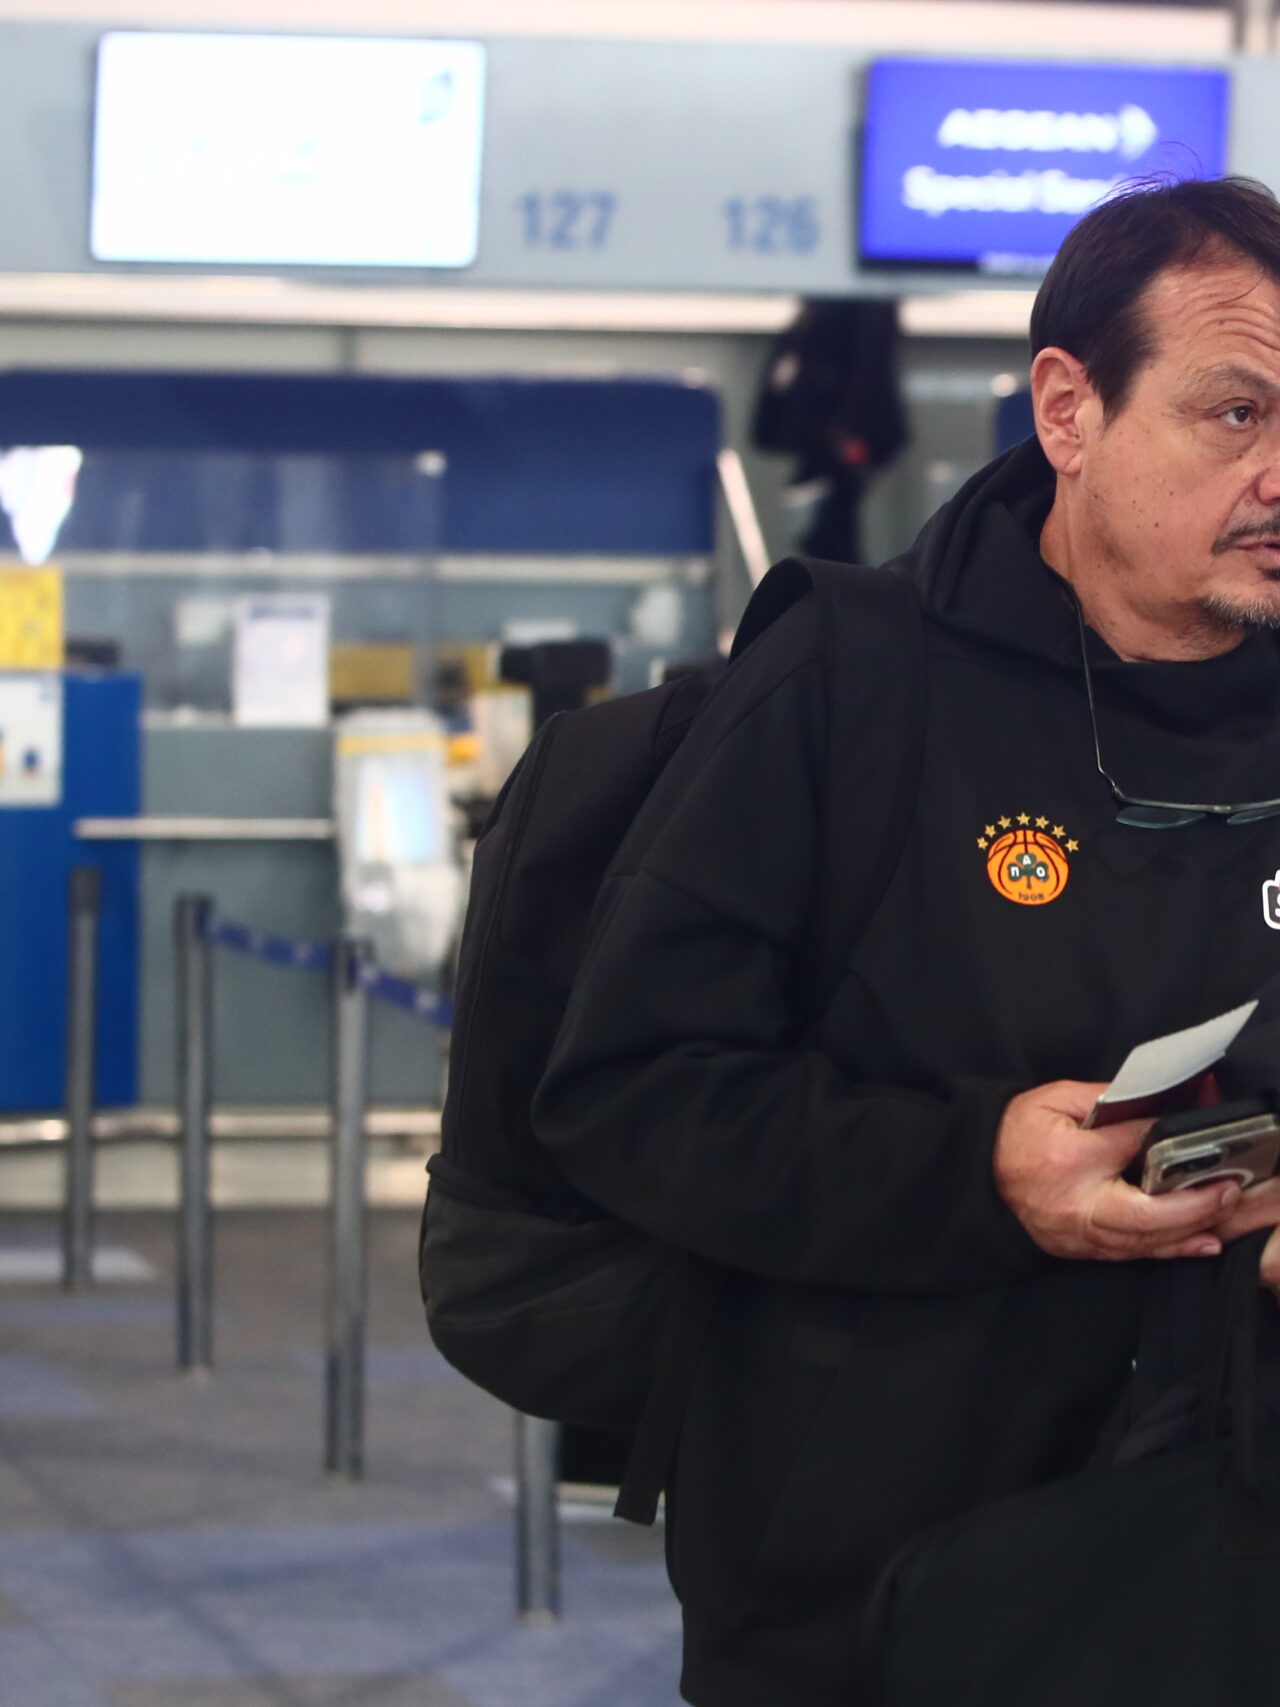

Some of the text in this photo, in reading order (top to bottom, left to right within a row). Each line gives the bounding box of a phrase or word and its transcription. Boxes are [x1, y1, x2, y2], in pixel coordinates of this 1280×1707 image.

[519, 191, 617, 250] 127
[903, 165, 1033, 217] Special
[725, 195, 819, 254] 126
